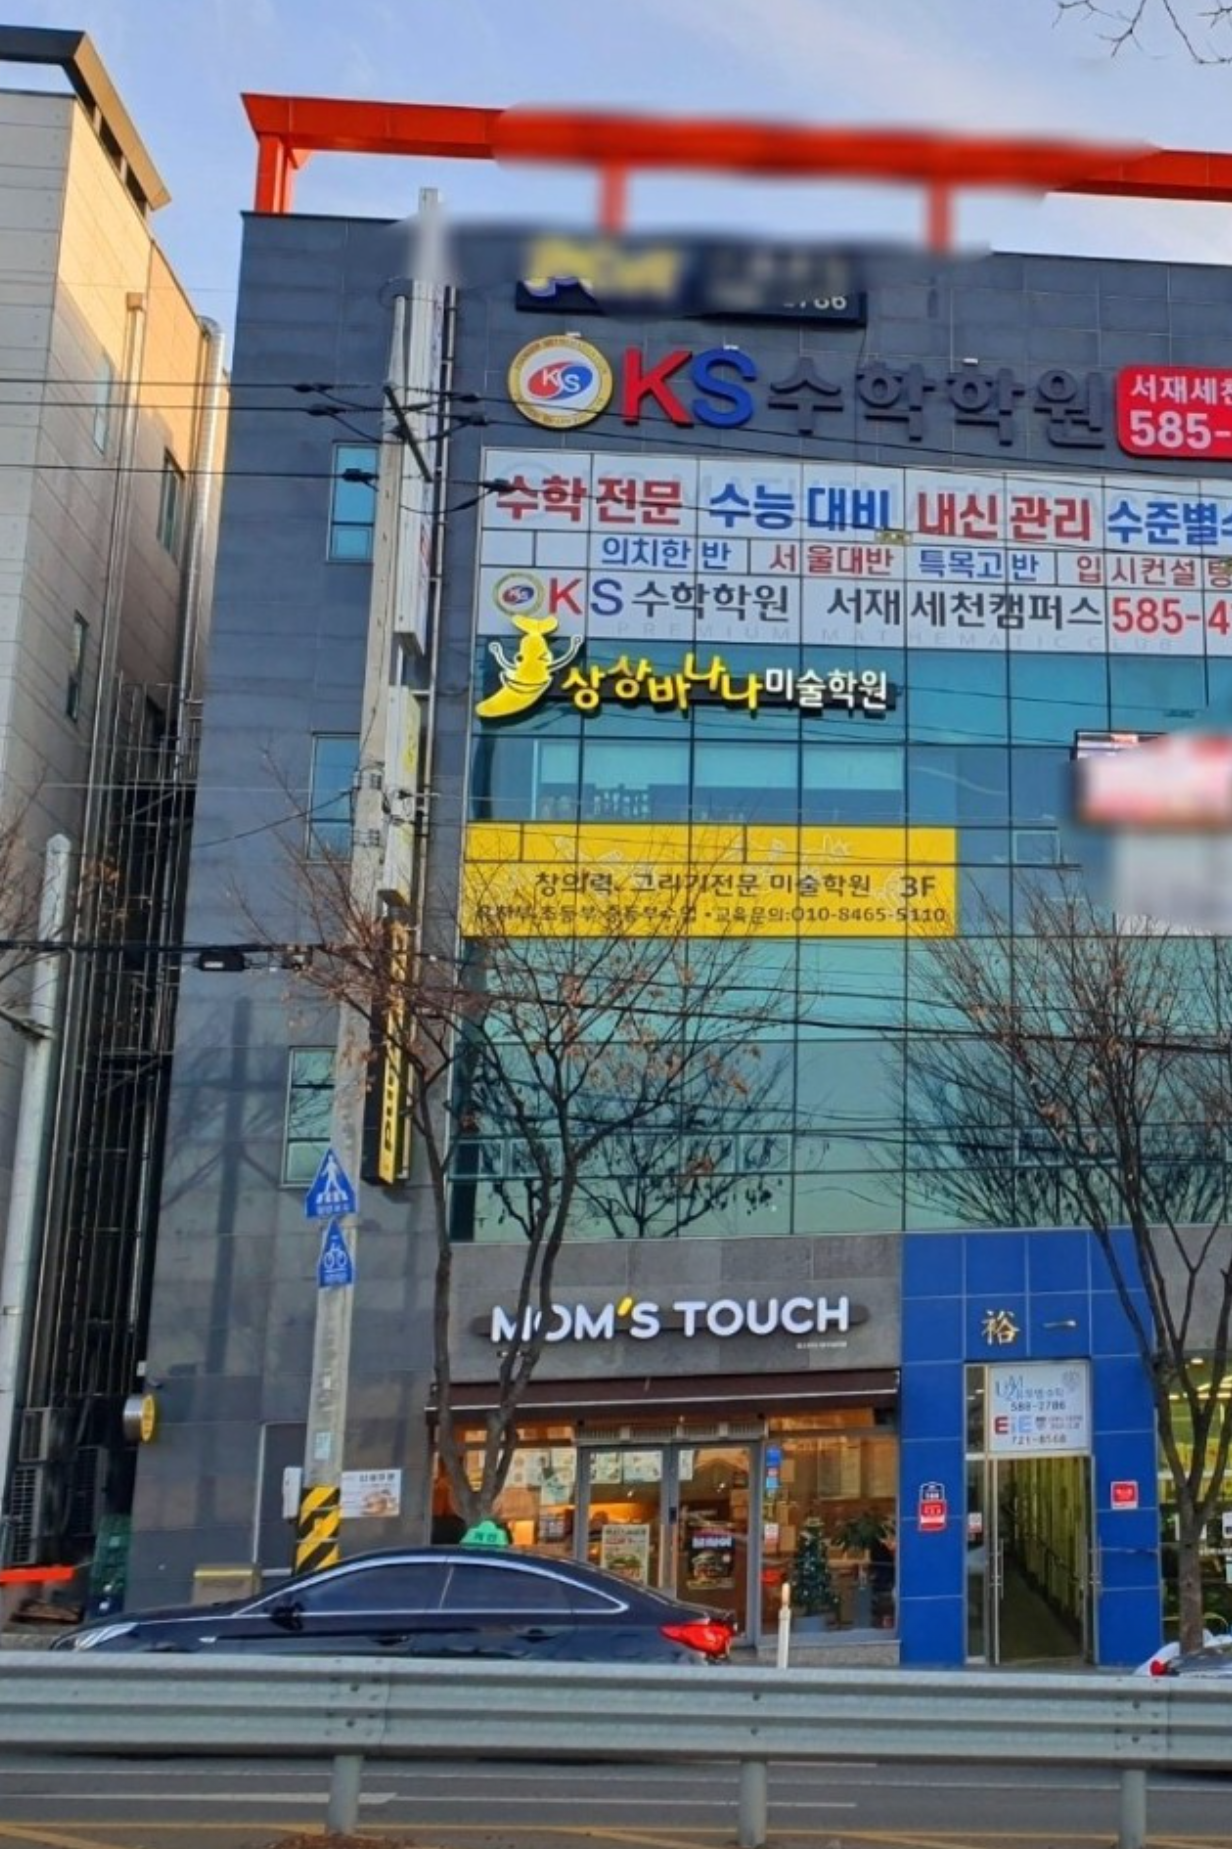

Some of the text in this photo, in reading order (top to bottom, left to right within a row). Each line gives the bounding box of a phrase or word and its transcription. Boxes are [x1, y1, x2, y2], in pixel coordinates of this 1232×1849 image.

[541, 368, 581, 393] KS
[597, 478, 682, 526] 전문
[710, 482, 795, 530] 수능
[807, 486, 890, 533] 대비
[917, 491, 999, 541] 내신
[1010, 496, 1091, 542] 관리
[900, 876, 936, 897] 3F
[673, 1295, 850, 1337] TOUCH
